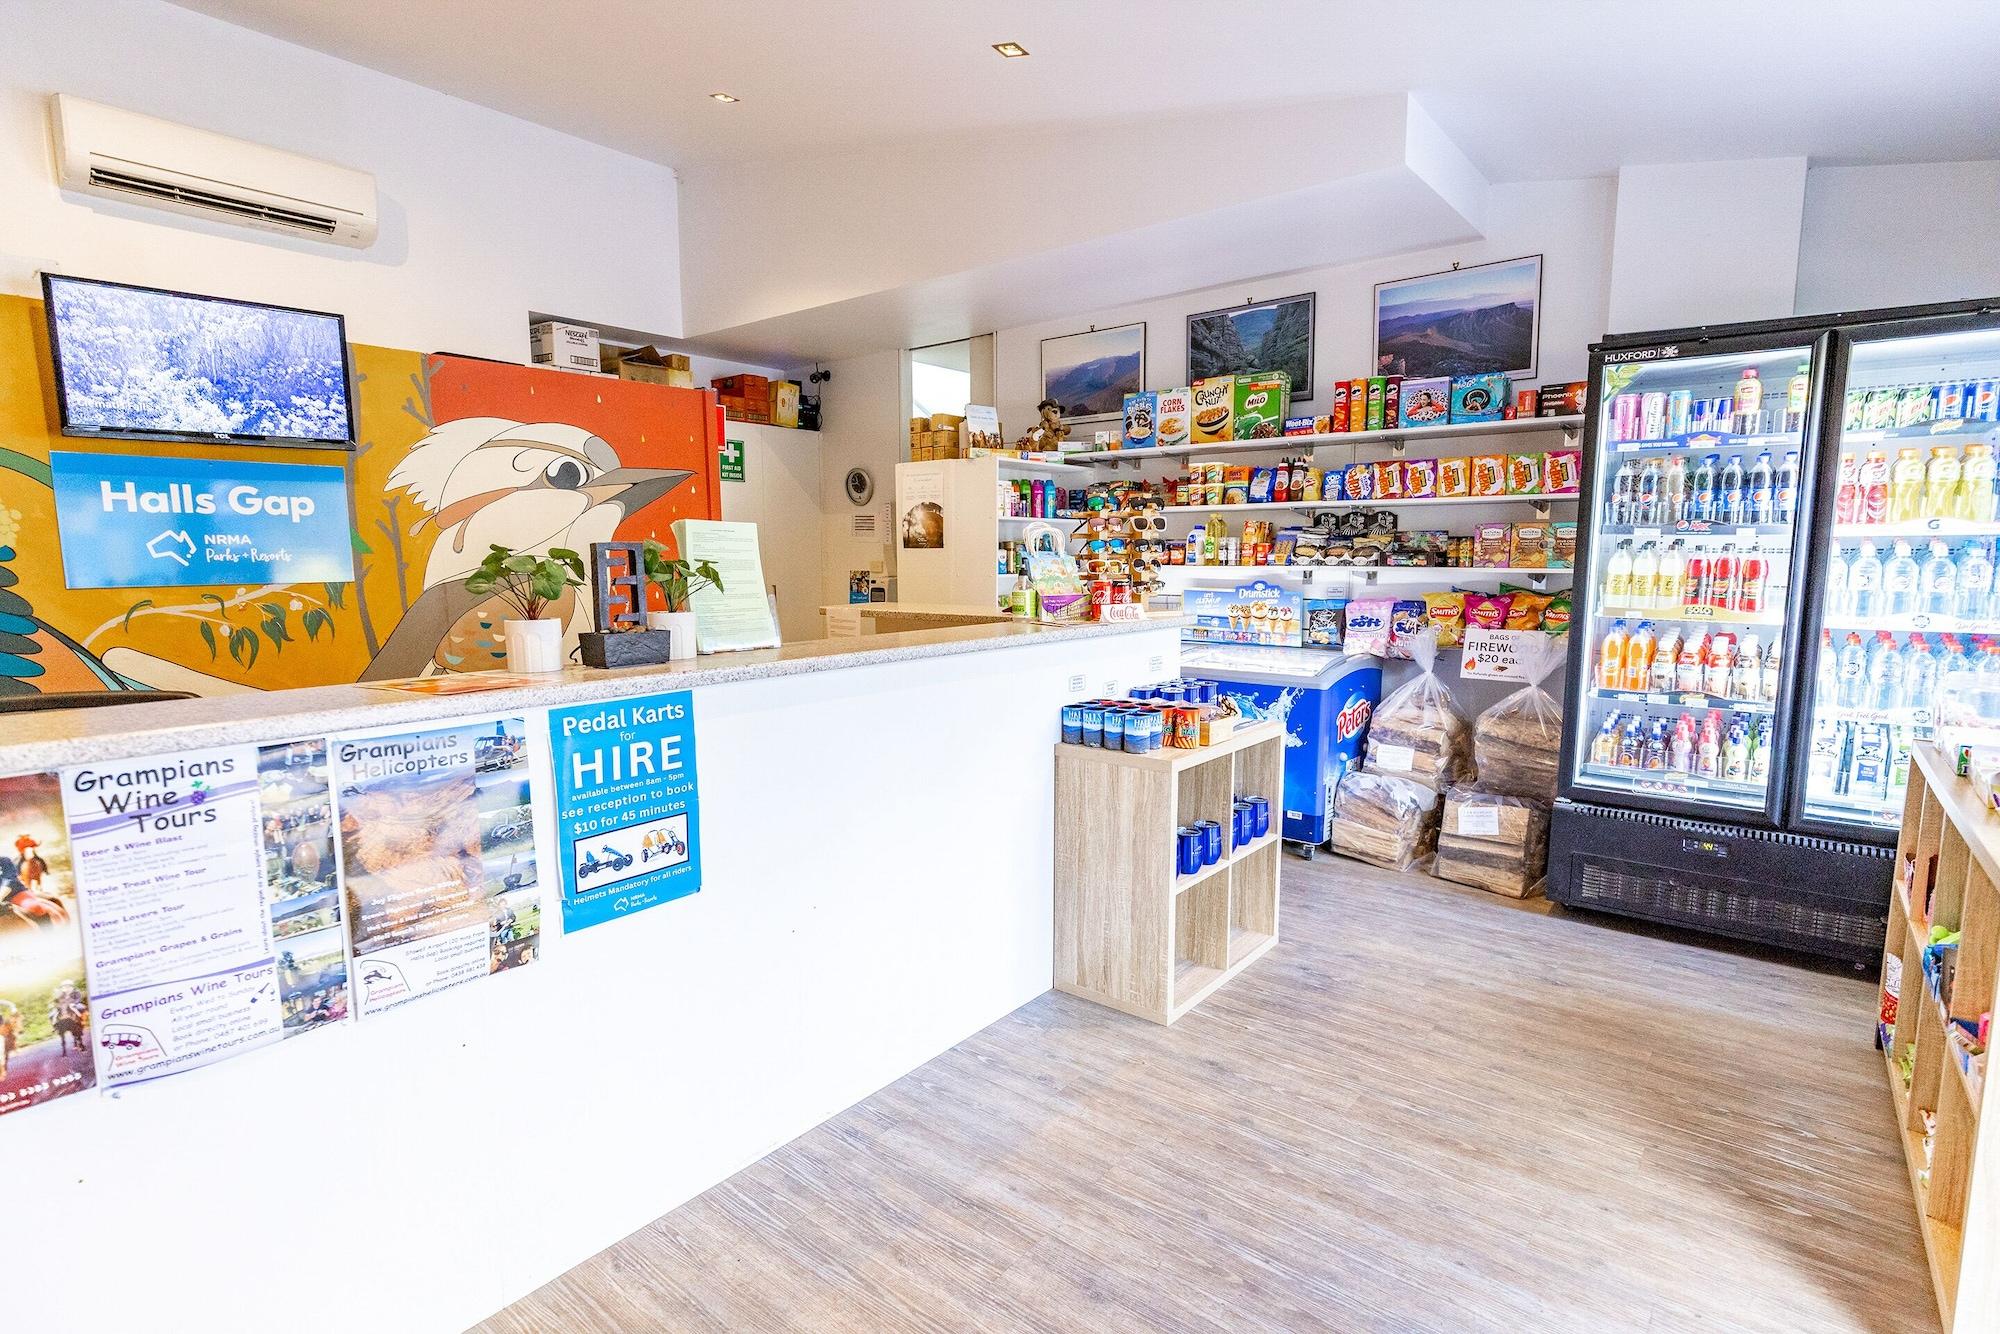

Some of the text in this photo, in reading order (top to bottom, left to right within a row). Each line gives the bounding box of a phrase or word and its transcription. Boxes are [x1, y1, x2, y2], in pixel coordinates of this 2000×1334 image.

[1604, 350, 1656, 362] HUXFORD
[1162, 398, 1182, 406] CORN
[1196, 384, 1228, 406] CRUNCHY
[1205, 398, 1220, 407] NUT
[1247, 396, 1266, 406] MILO
[1160, 404, 1184, 414] FLAKES
[1286, 419, 1314, 428] Weet-Bix
[100, 481, 315, 523] Halls Gap
[1928, 519, 1940, 530] G
[204, 534, 251, 545] NRMA
[206, 548, 240, 562] Parks
[251, 548, 293, 562] Resorts
[1239, 588, 1280, 600] Drumstick
[1348, 618, 1382, 628] Soft
[1686, 607, 1713, 616] SOLO
[1478, 654, 1498, 663] $20
[562, 702, 685, 737] Pedal Karts
[1337, 699, 1372, 743] Peters
[619, 730, 636, 742] for
[339, 735, 458, 763] Grampians
[351, 749, 468, 781] Helicopters
[572, 735, 683, 789] HIRE
[74, 758, 234, 792] Grampians
[571, 787, 609, 802] available
[610, 780, 644, 794] between
[645, 776, 662, 786] 8am
[668, 772, 685, 784] 5pm
[98, 790, 179, 815] Wine
[561, 781, 695, 820] see reception to book
[129, 808, 217, 833] Tours
[573, 800, 686, 836] $10 for 45 minutes
[82, 847, 110, 858] Beer
[124, 840, 152, 850] Wine
[155, 835, 184, 846] Blast
[86, 867, 207, 897] Triple Treat Wine Tour
[573, 864, 693, 906] Helmets Mandatory for all riders
[90, 904, 186, 930] Wine Lovers Tour
[96, 949, 156, 970] Grampians
[159, 939, 198, 954] Grapes
[210, 928, 243, 942] Grains
[101, 966, 274, 1021] Grampians Wine Tours
[107, 1026, 281, 1080] www.grampianswinetours.com.au
